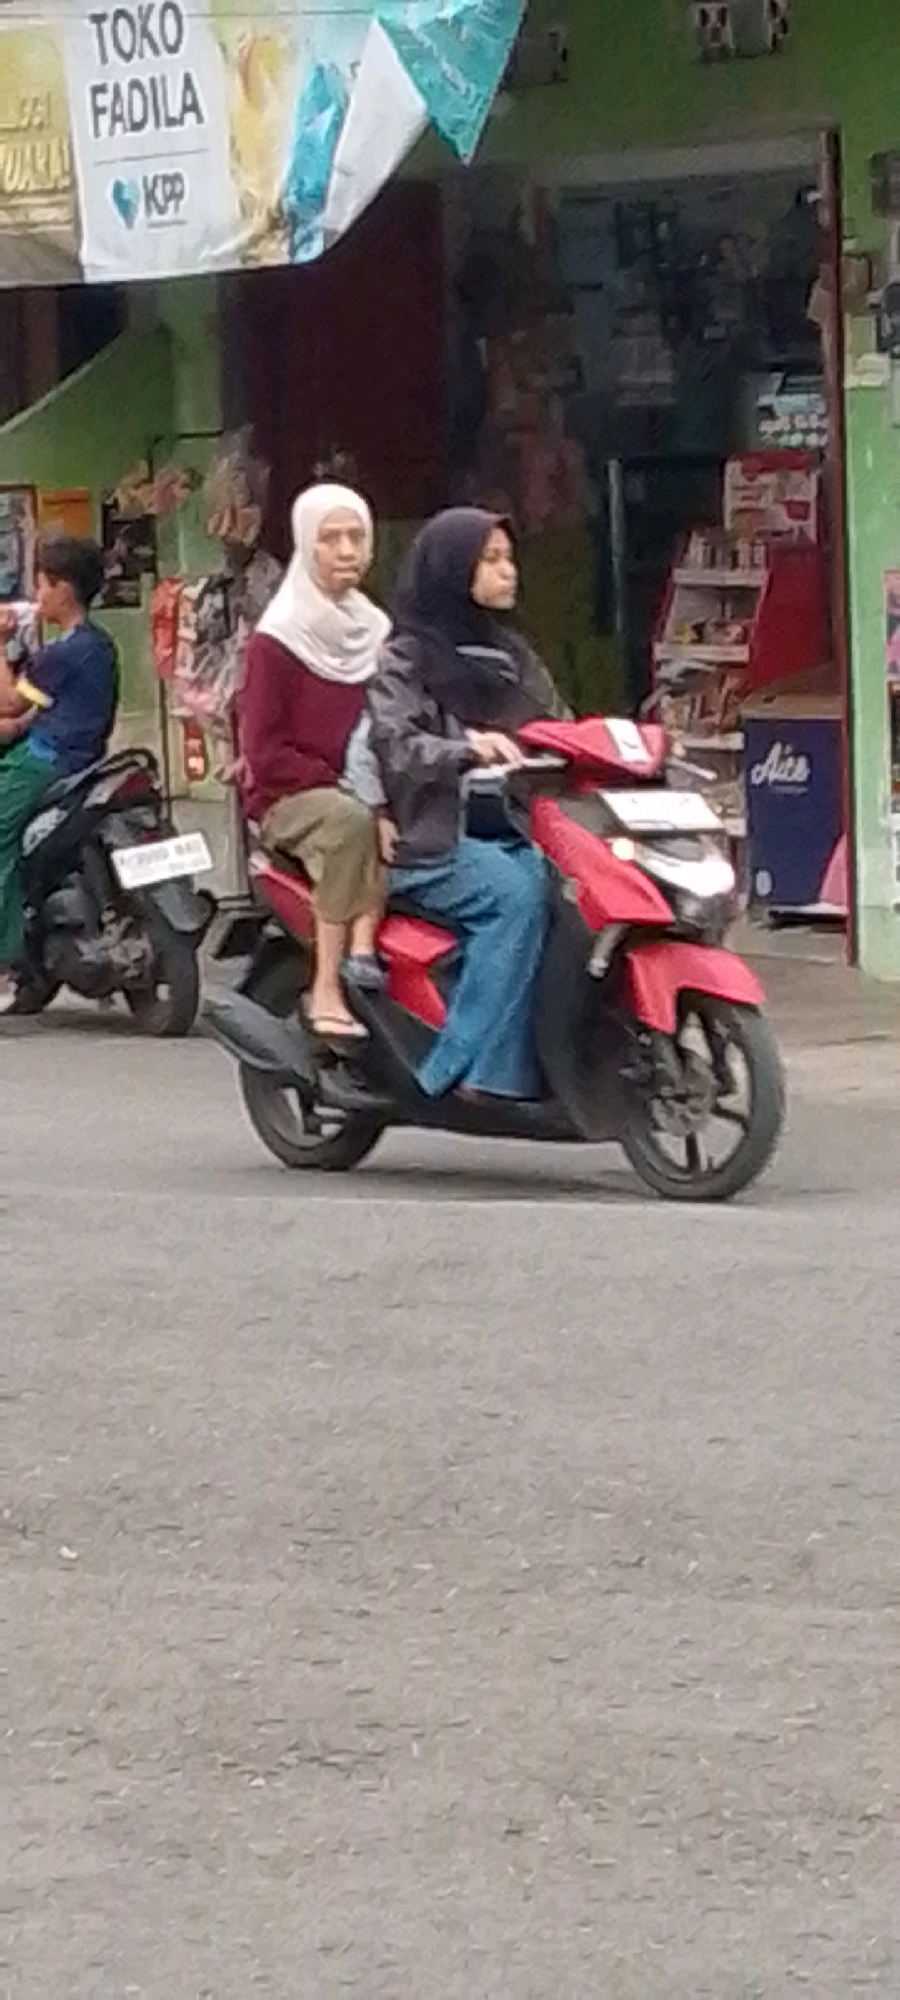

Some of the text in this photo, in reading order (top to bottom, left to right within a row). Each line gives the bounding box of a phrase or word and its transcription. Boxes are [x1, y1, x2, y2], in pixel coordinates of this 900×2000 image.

[89, 1, 184, 65] TOKO
[89, 71, 204, 138] FADILA
[143, 172, 185, 218] KPP
